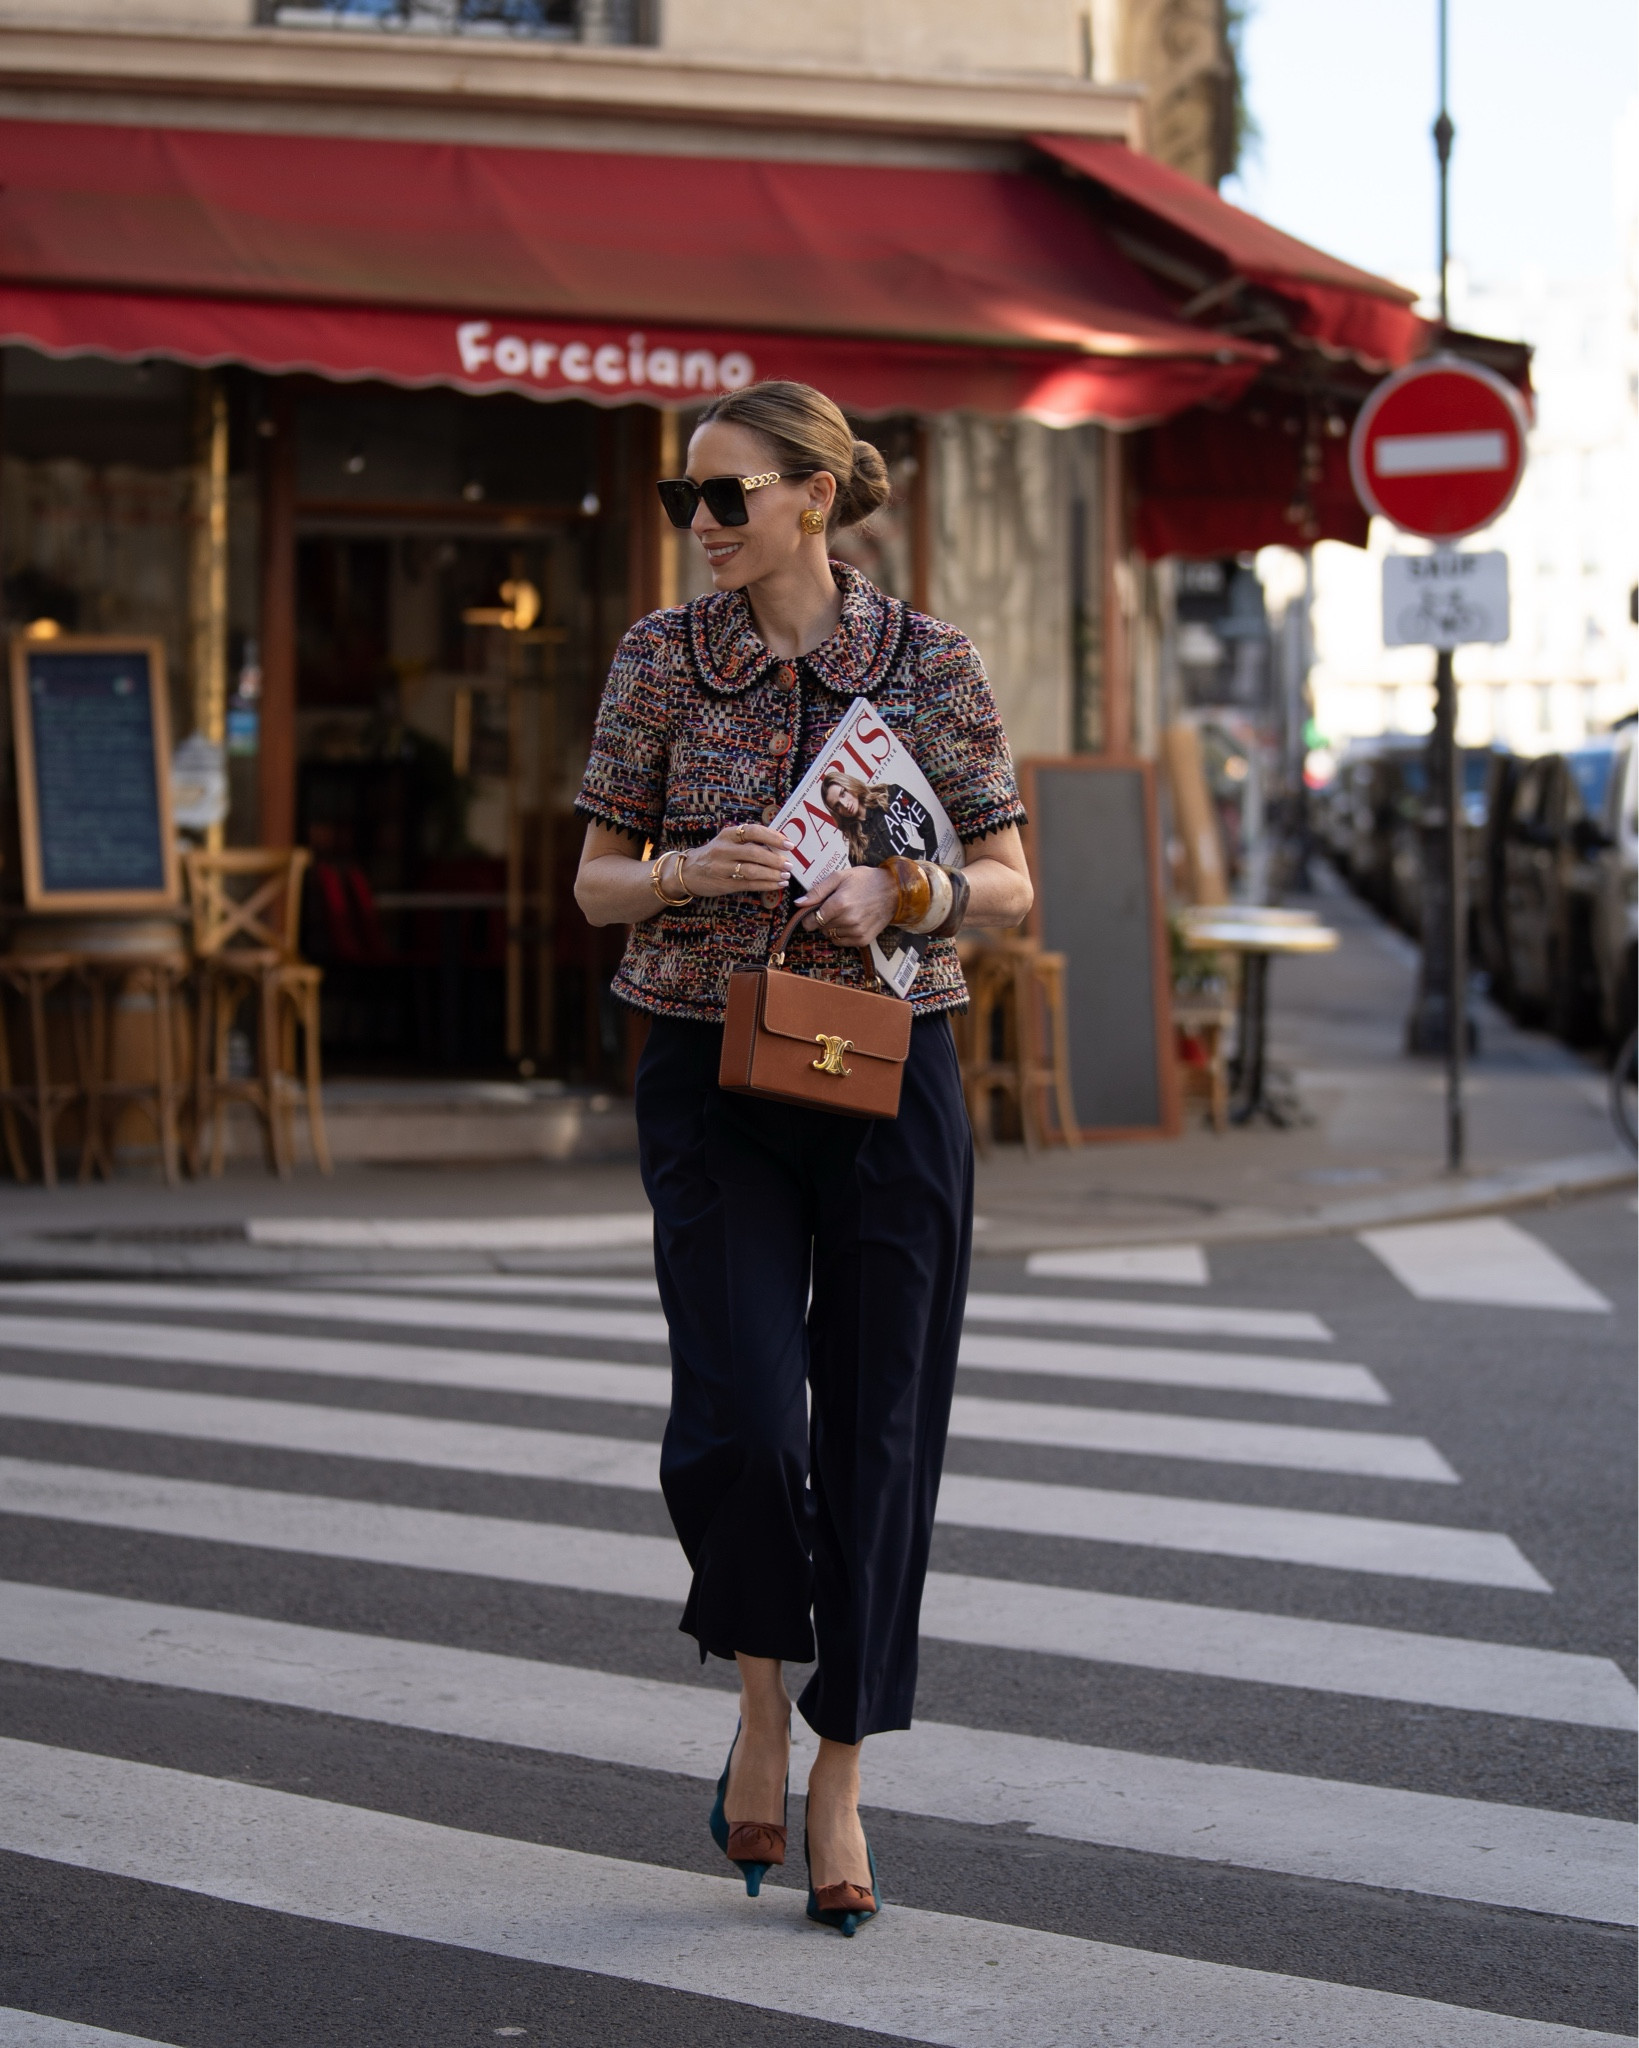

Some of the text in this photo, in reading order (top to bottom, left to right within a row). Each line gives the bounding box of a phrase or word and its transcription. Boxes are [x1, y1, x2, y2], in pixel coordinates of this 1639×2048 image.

[456, 320, 755, 390] Forcciano
[871, 748, 897, 785] CAPITALE
[884, 789, 911, 836] ART
[890, 801, 927, 856] LUXE
[811, 850, 840, 887] INTERVIEWS
